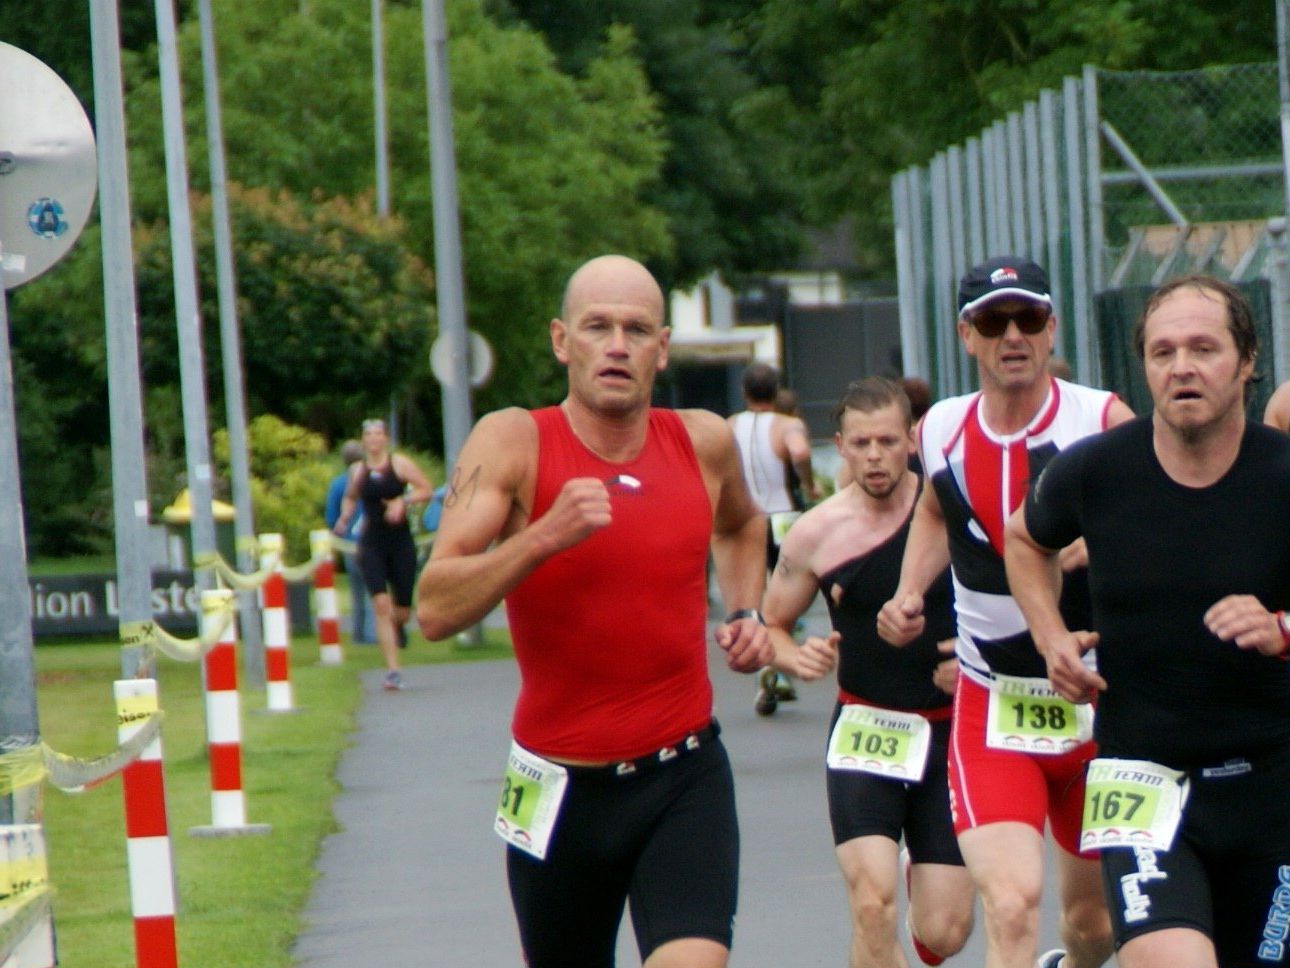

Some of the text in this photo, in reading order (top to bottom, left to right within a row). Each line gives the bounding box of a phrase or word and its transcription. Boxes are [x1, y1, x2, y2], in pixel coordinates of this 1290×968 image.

[1011, 701, 1067, 731] 138
[850, 730, 900, 758] 103
[1114, 769, 1164, 787] TEAM
[1091, 789, 1146, 822] 167
